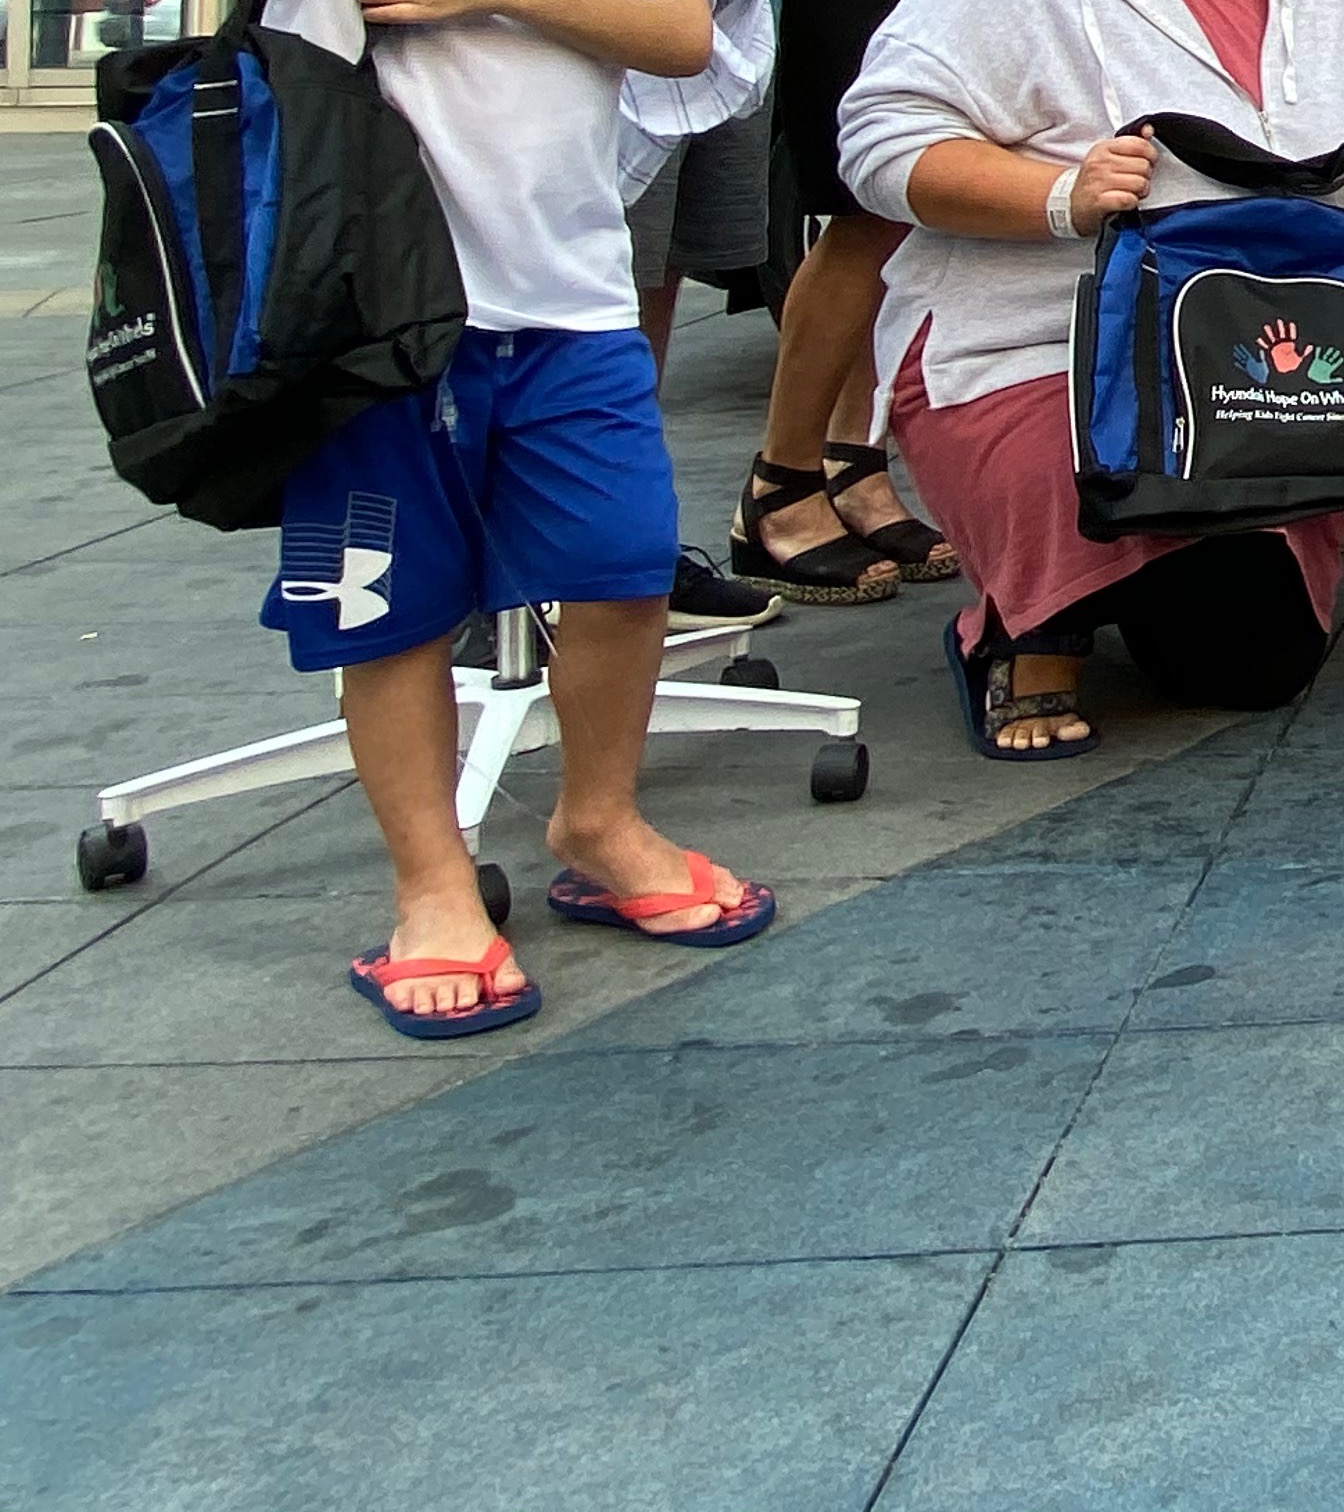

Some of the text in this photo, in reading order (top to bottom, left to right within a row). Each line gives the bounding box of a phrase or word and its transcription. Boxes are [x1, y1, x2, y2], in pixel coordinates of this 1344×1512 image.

[1211, 384, 1264, 404] Hyundai
[1265, 390, 1299, 408] Hope
[1300, 390, 1319, 405] On
[1215, 409, 1254, 422] Helping
[1296, 413, 1326, 422] Cancer
